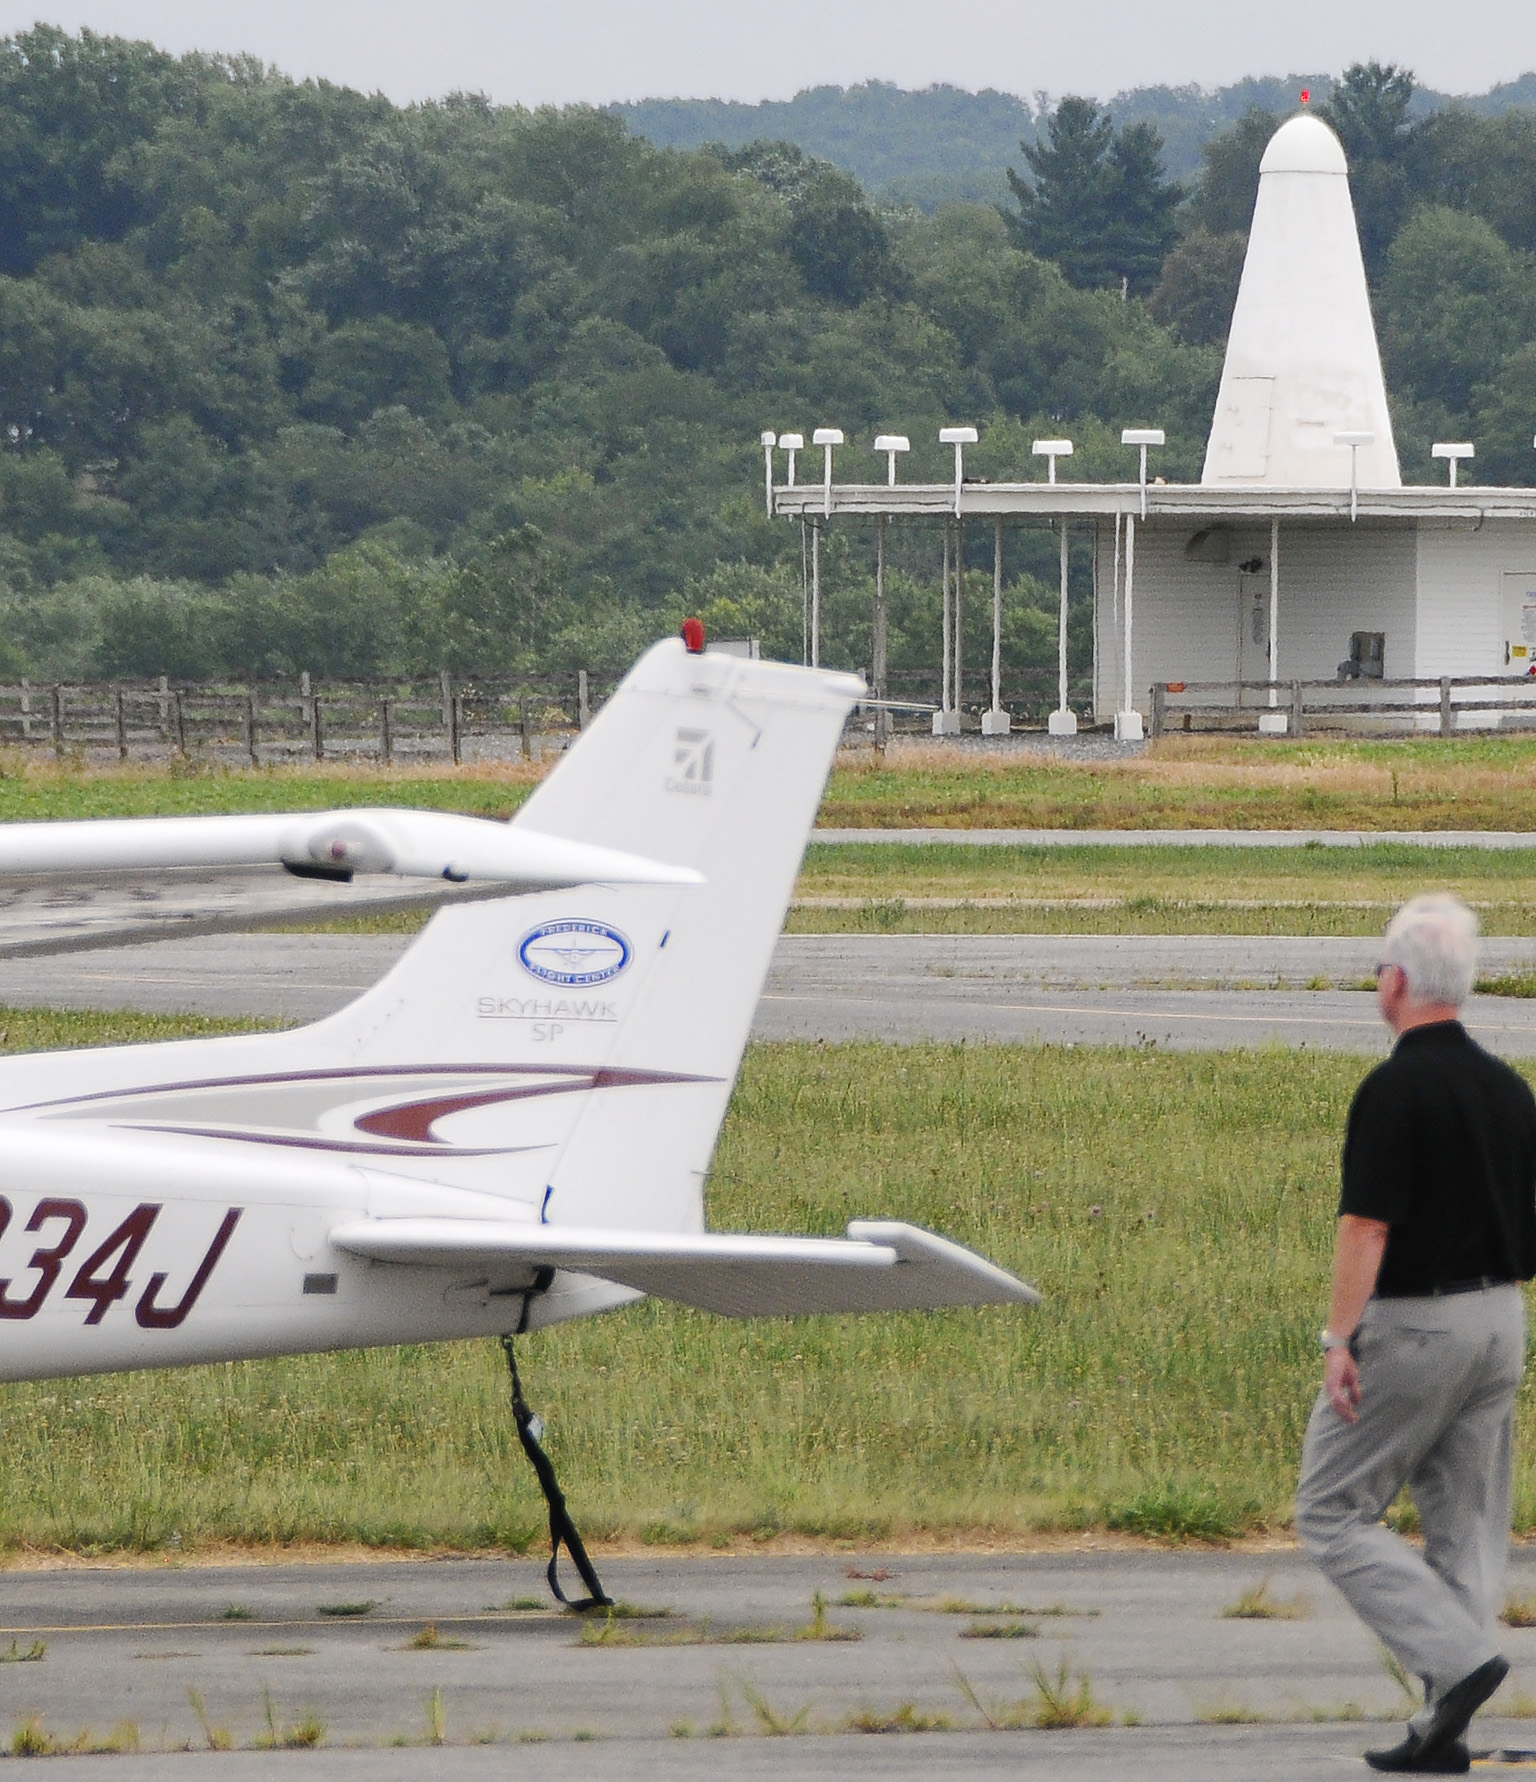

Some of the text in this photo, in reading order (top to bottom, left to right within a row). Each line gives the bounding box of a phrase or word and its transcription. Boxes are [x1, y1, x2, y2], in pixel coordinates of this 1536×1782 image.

[540, 923, 608, 937] FREDERICK
[529, 962, 572, 983] FLIGHT
[478, 997, 618, 1018] SKYHAWK
[532, 1023, 563, 1042] SP
[0, 1194, 245, 1329] 34J
